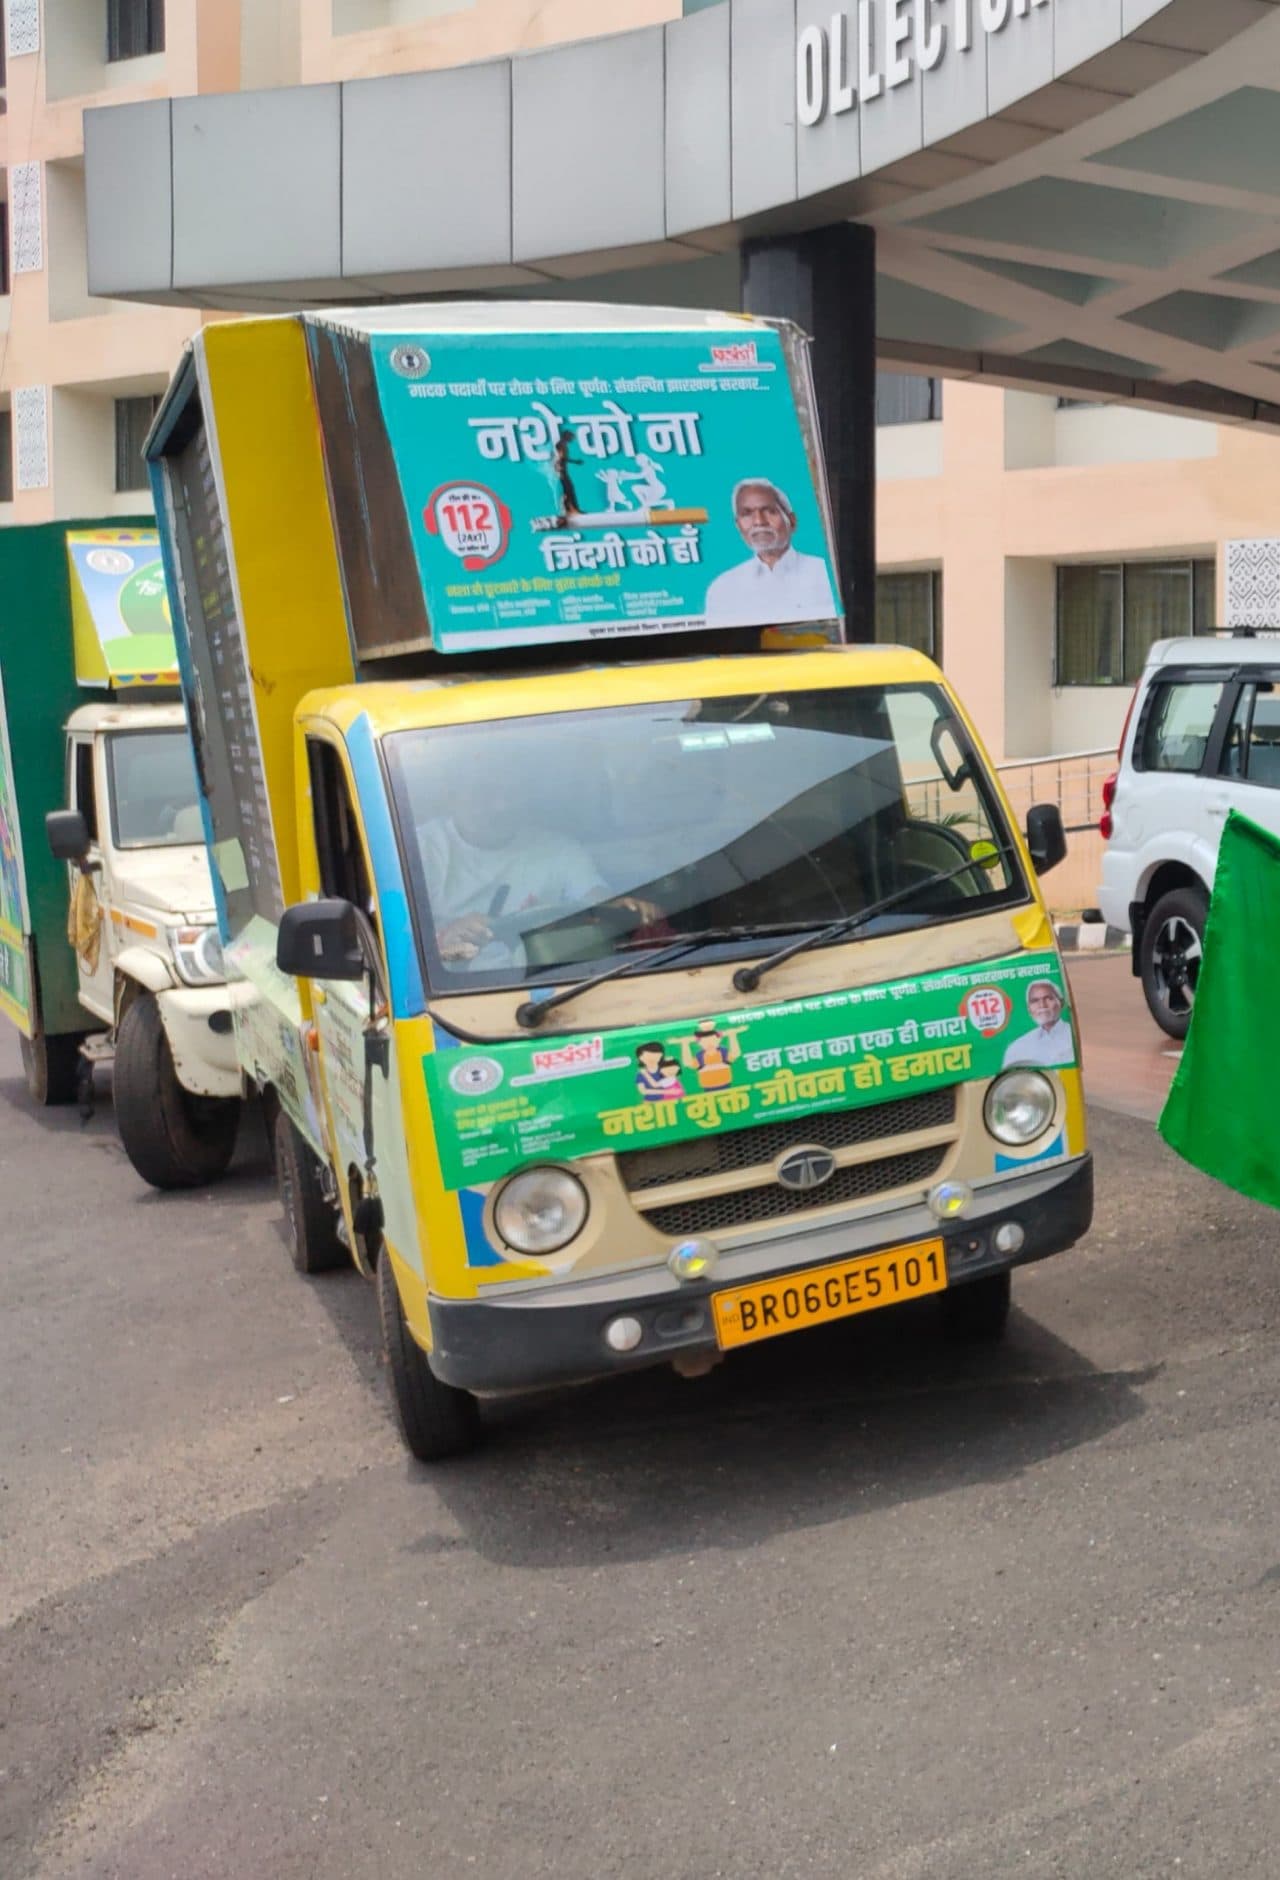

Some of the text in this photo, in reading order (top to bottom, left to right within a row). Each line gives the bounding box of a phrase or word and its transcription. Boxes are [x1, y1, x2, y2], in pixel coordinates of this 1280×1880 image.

[797, 0, 1051, 127] OLLECT
[468, 400, 703, 462] नशे को ना
[443, 503, 493, 532] 112
[540, 523, 700, 571] जिंदगी को हाँ
[971, 997, 1000, 1016] 112
[743, 1016, 968, 1072] हम सब का एक ही नारा
[597, 1099, 680, 1135] नशा
[681, 1085, 752, 1128] मुक्त
[753, 1069, 846, 1107] जीवन
[848, 1054, 883, 1089] हो
[886, 1044, 972, 1082] हमारा
[739, 1251, 939, 1332] BR06GE5101
